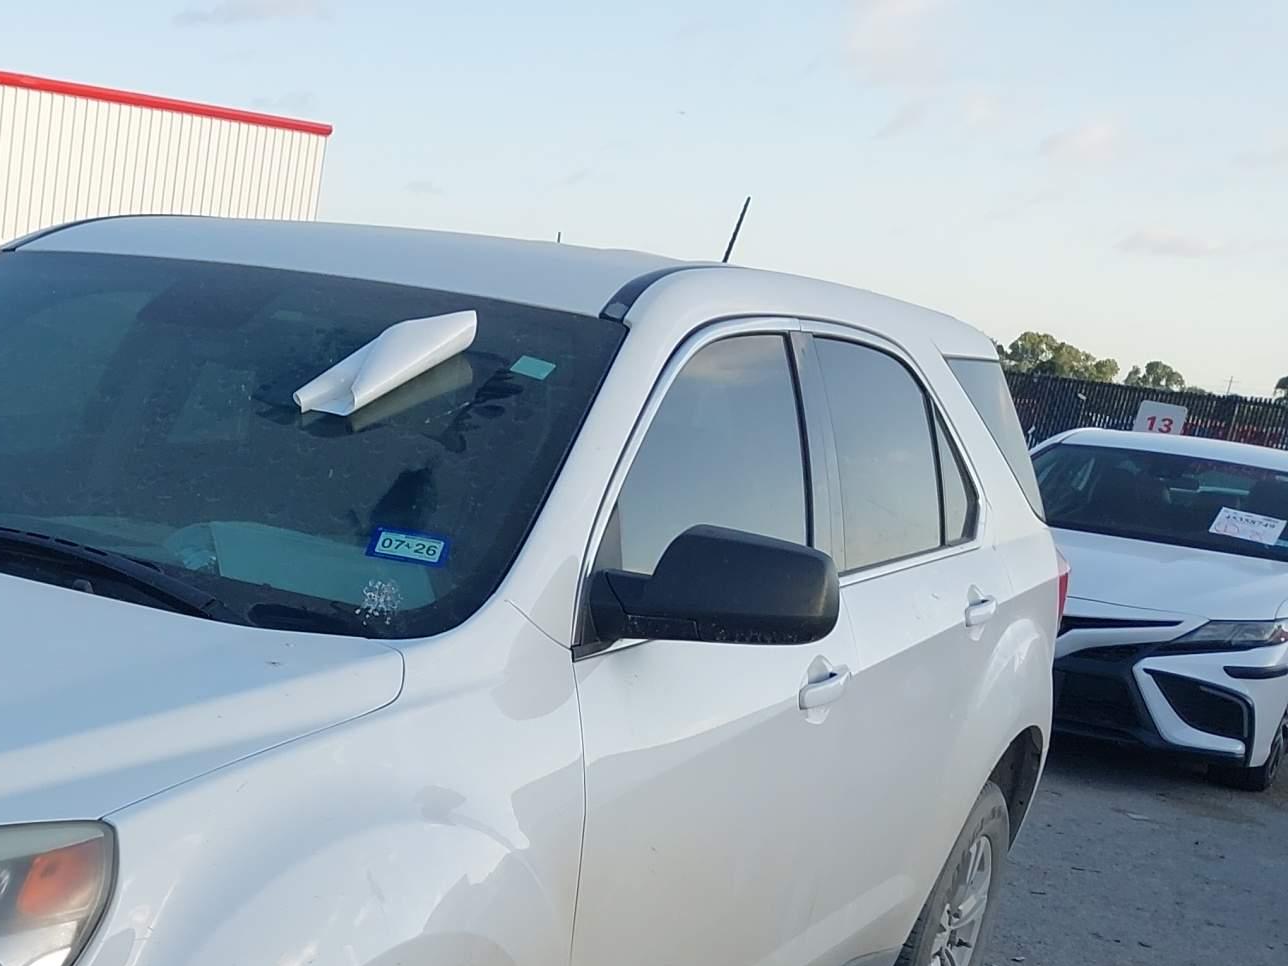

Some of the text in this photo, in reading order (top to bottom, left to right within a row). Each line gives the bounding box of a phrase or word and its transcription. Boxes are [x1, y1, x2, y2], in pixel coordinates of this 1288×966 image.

[1146, 415, 1174, 433] 13
[381, 537, 438, 557] 07 26
